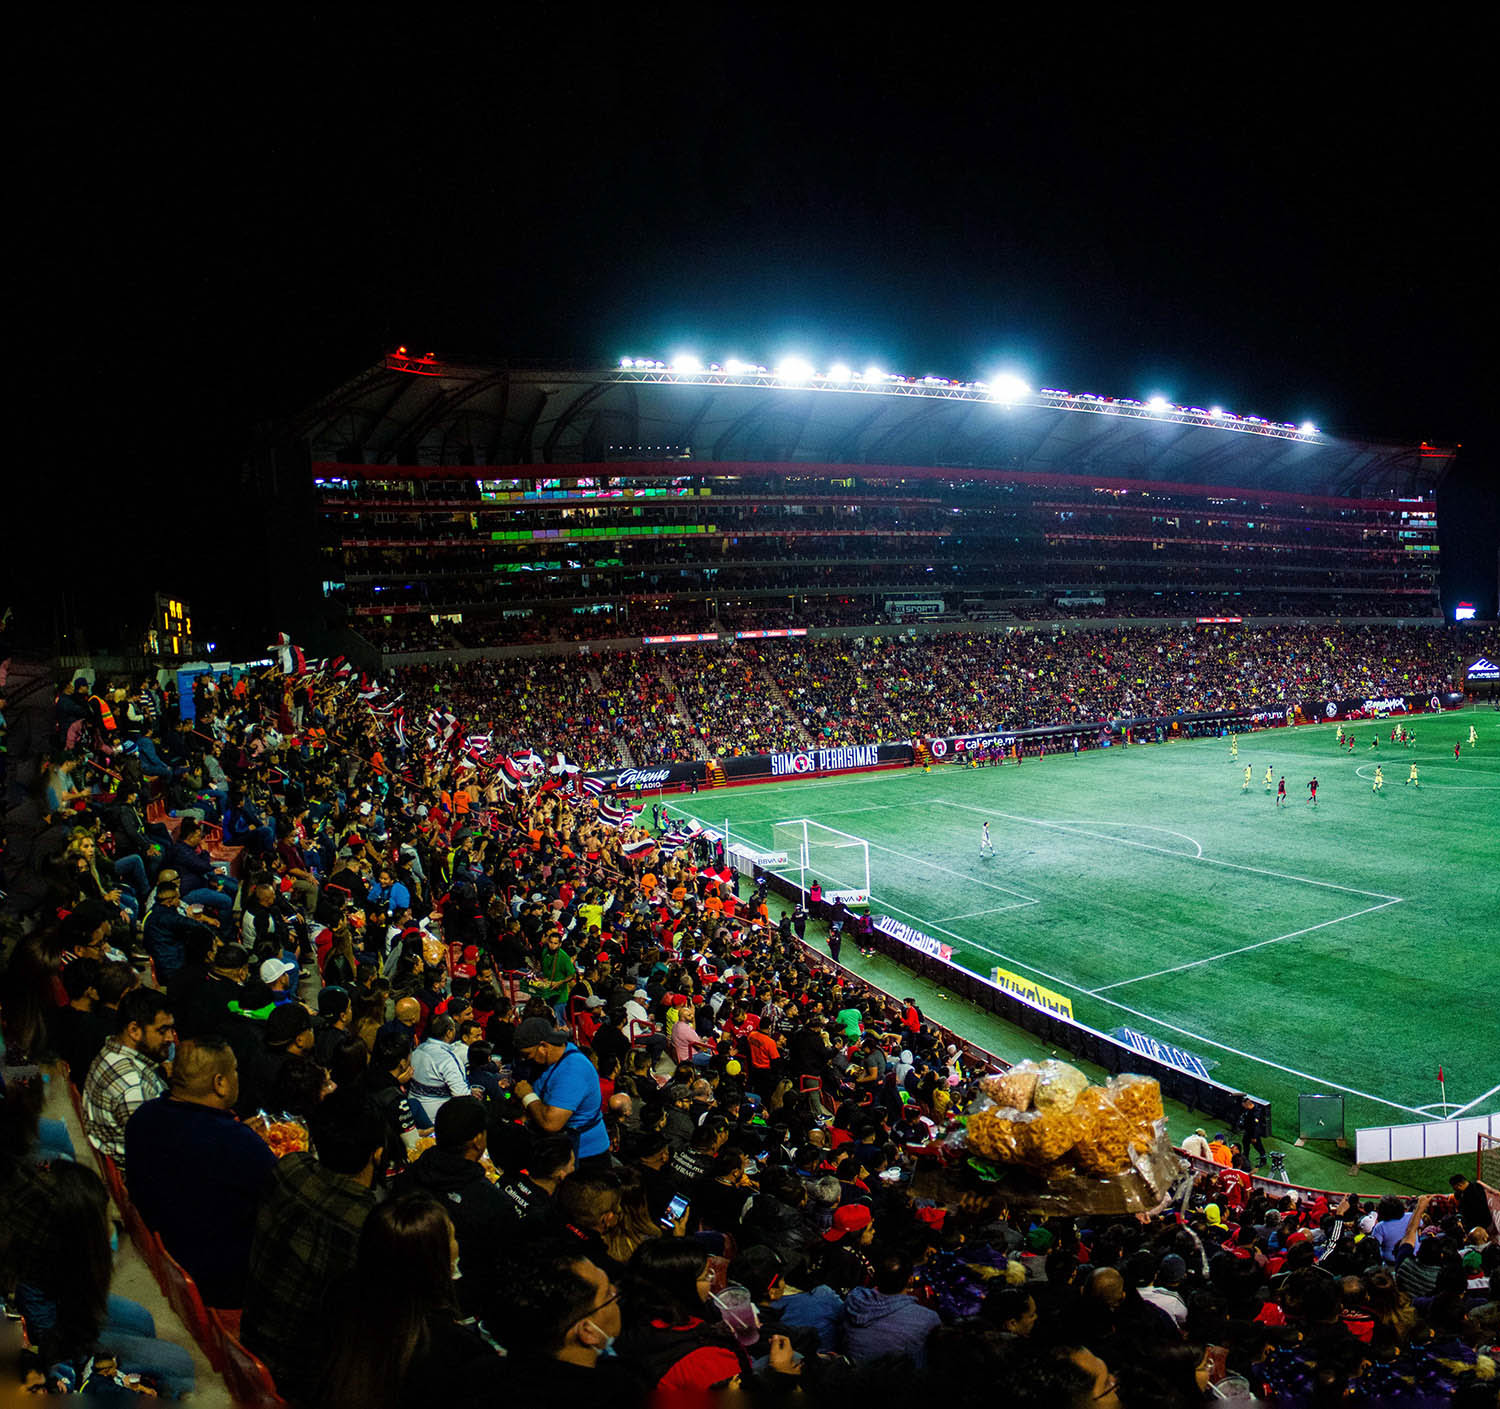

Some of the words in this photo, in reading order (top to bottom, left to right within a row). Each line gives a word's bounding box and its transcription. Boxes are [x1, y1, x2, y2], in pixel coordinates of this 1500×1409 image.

[771, 752, 815, 776] SOMOS
[616, 768, 671, 787] Caliente
[1226, 1180, 1237, 1194] 7
